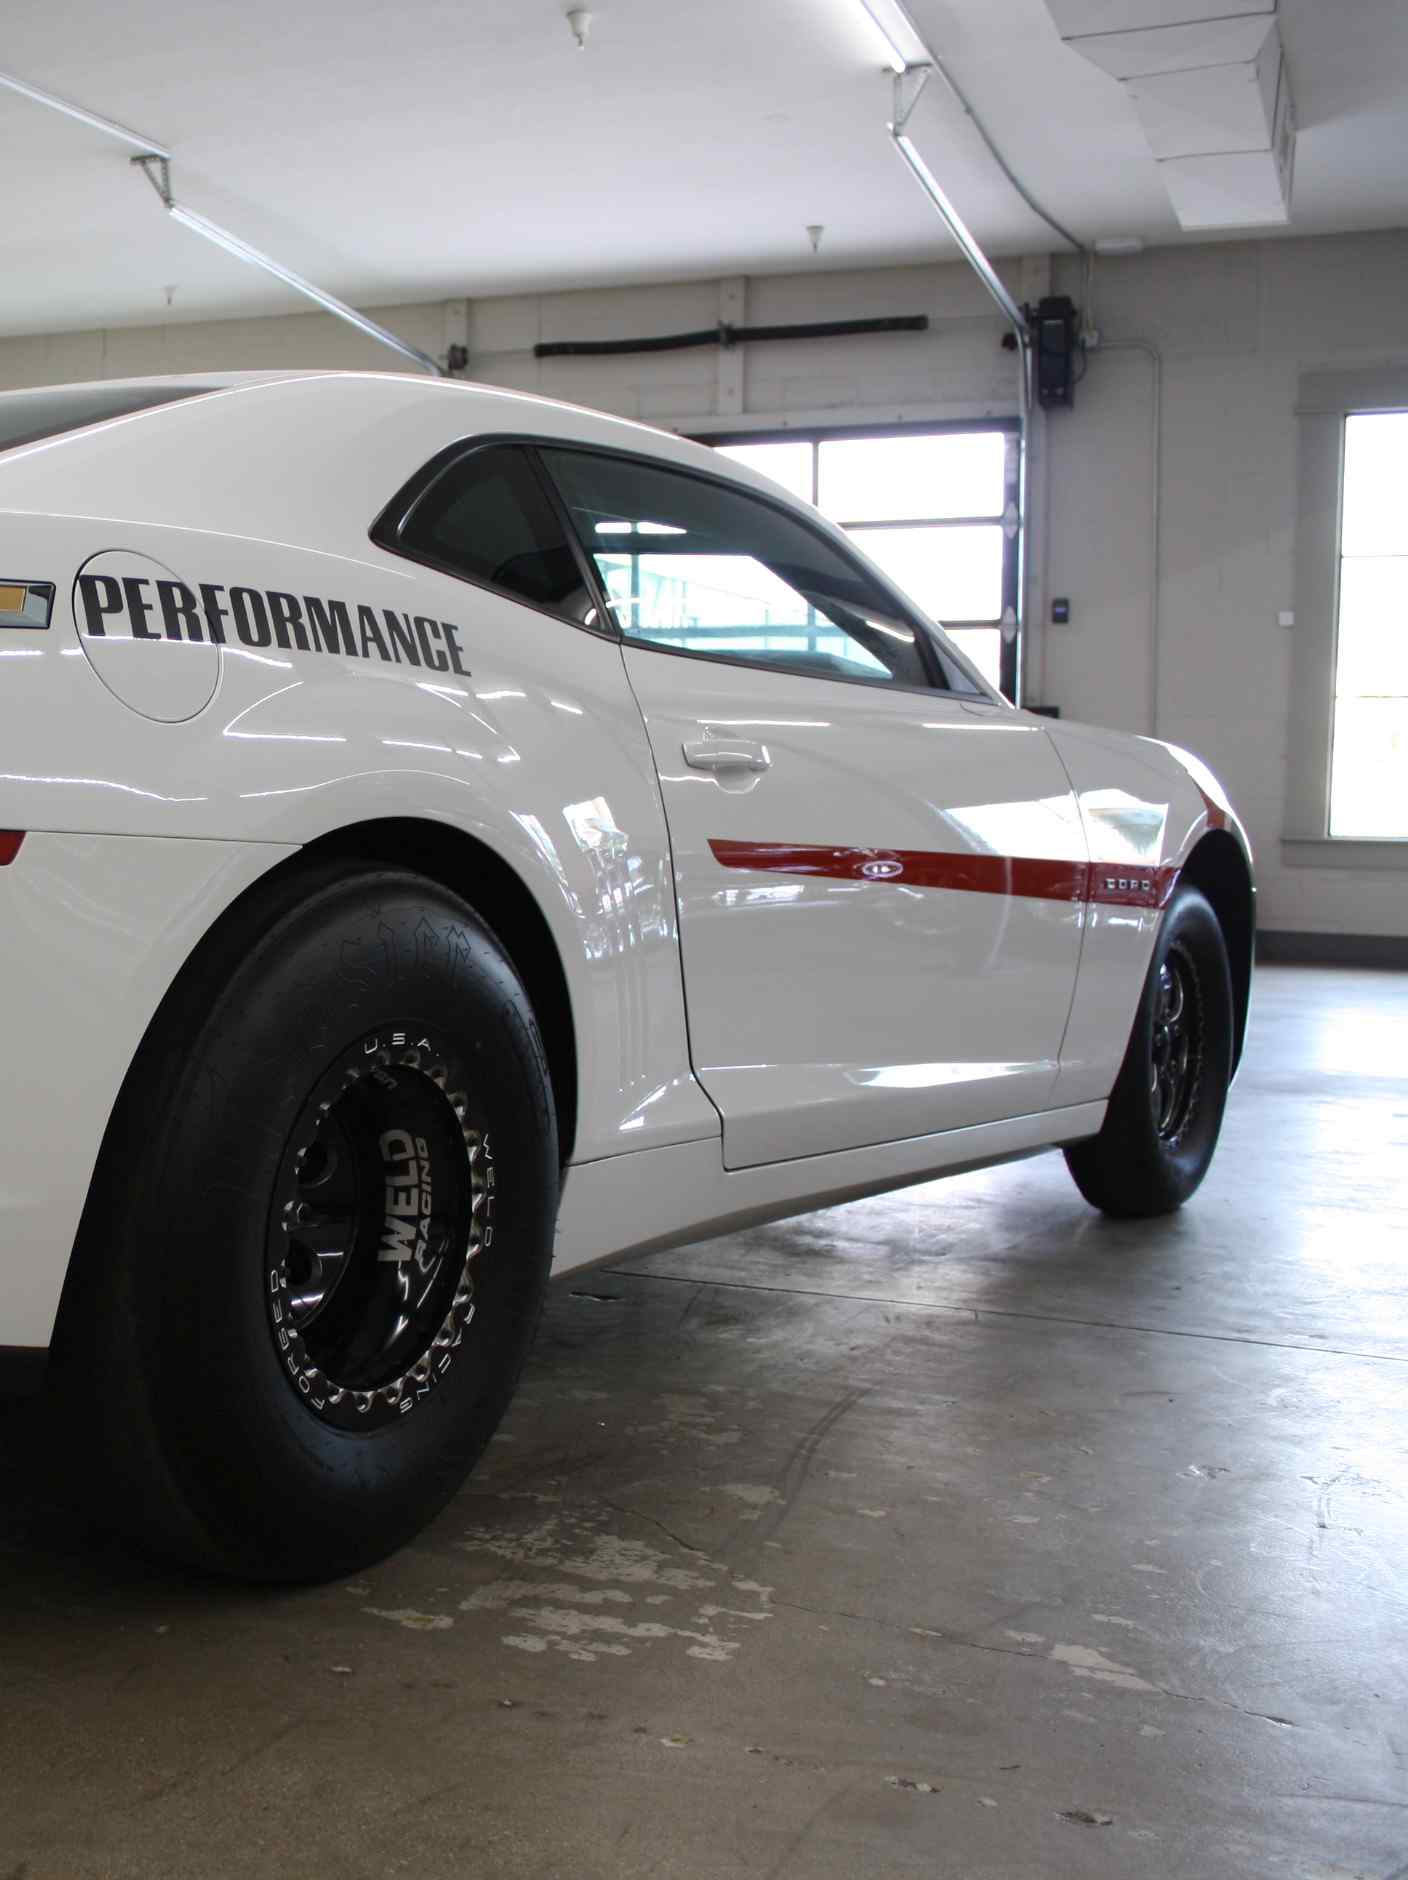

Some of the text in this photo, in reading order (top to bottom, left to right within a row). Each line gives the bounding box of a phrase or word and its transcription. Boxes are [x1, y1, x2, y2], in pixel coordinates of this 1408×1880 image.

[79, 574, 472, 677] PERFORMANCE
[1106, 878, 1151, 890] COPO
[364, 1032, 440, 1055] U.S.A.
[378, 1129, 418, 1263] WELD
[414, 1137, 433, 1264] RACING
[483, 1133, 496, 1247] WELD
[271, 1269, 326, 1410] FORGED
